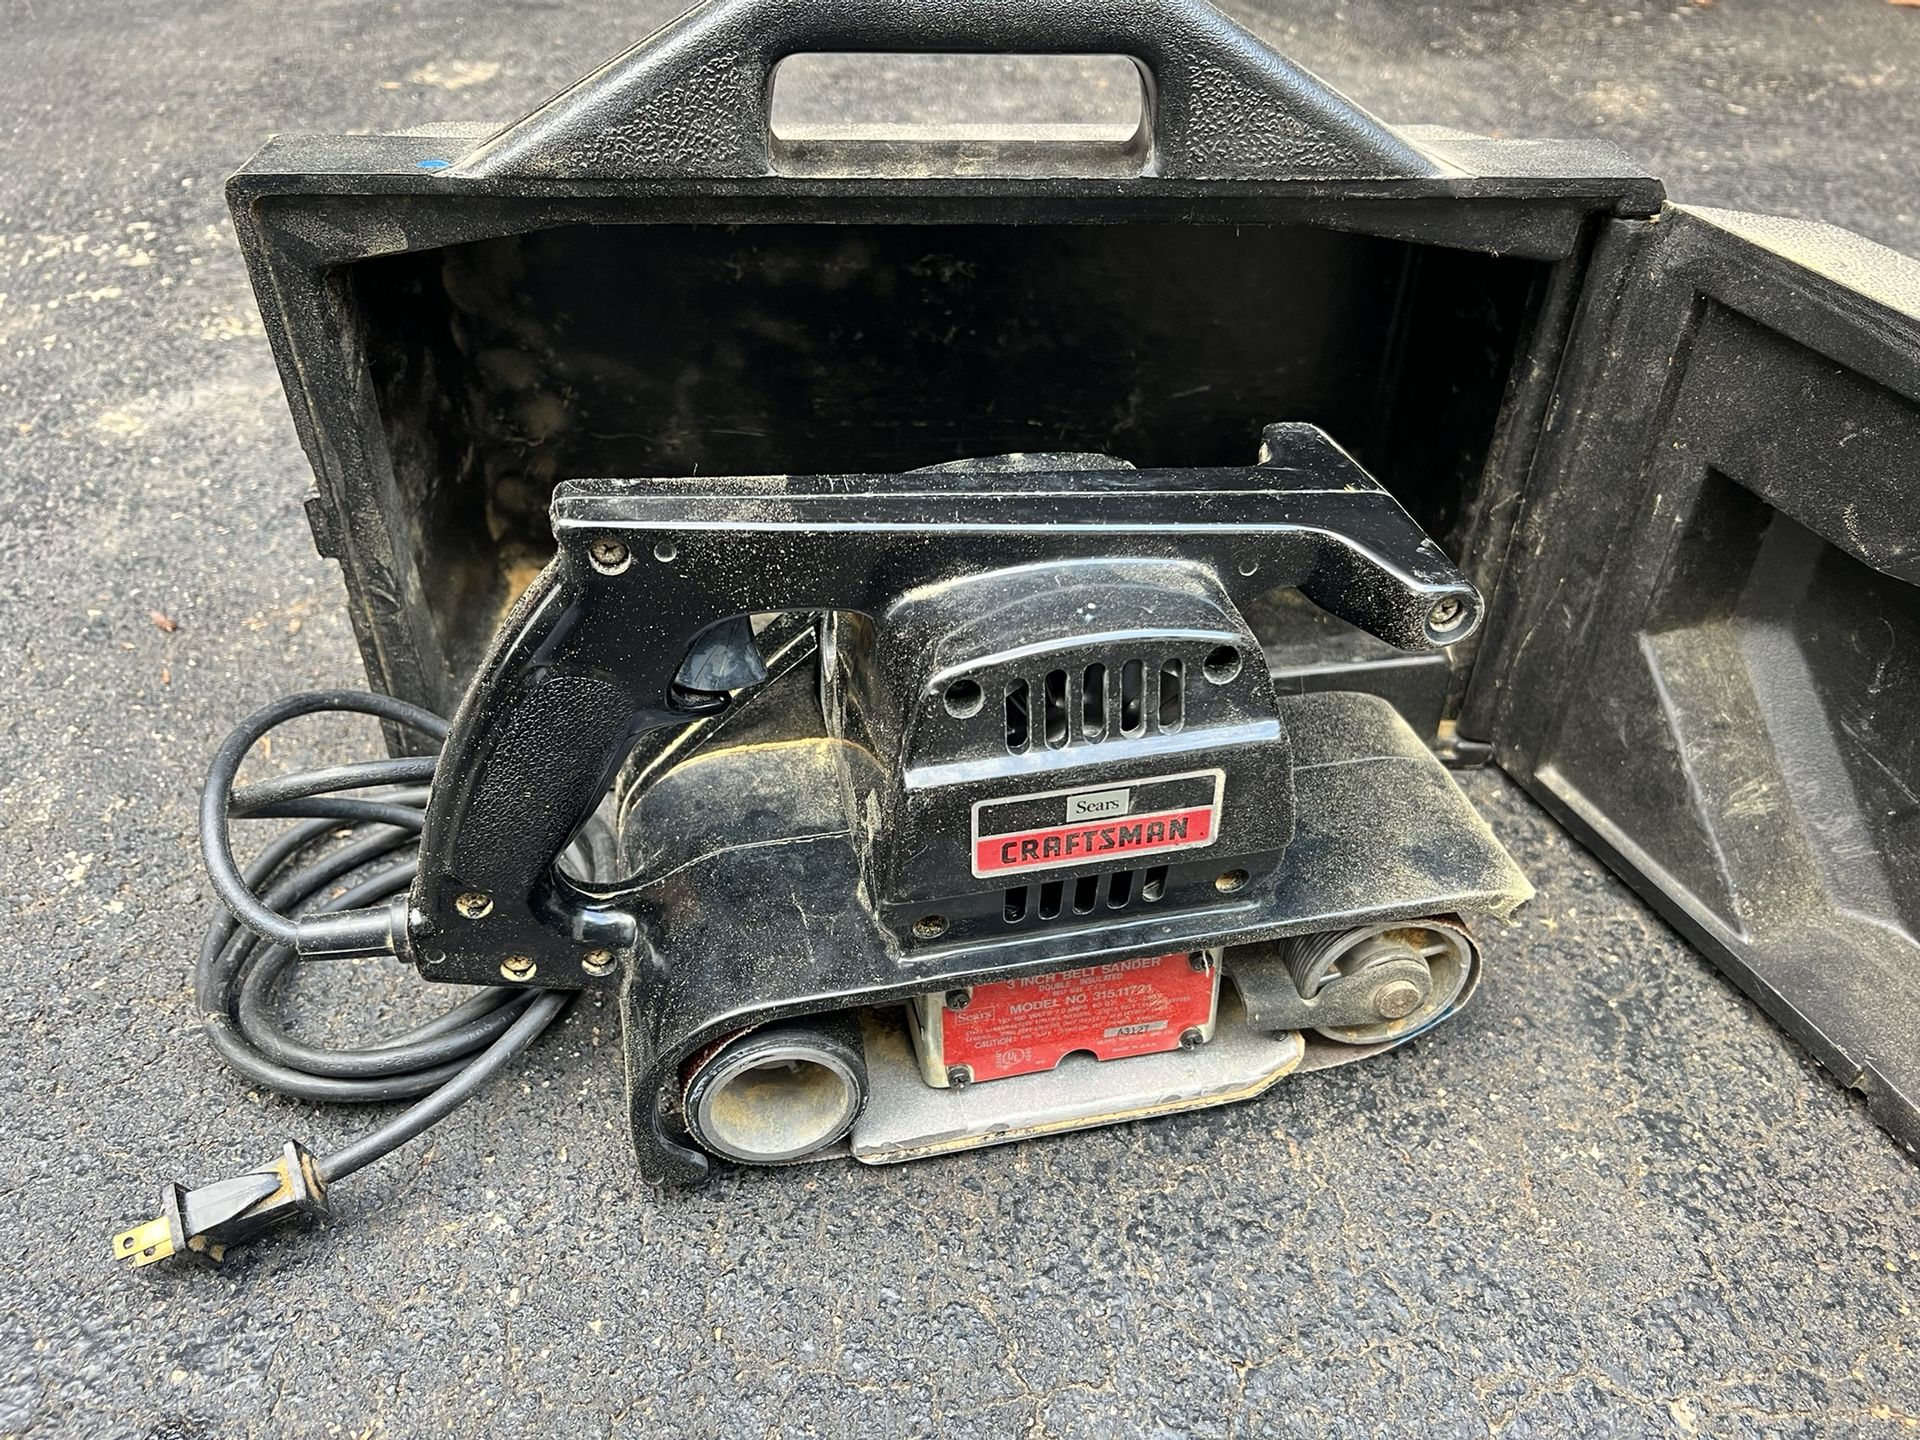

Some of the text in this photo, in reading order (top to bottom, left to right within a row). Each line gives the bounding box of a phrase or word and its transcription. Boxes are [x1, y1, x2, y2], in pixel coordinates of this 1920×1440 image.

[1075, 799, 1120, 815] Sears
[1001, 817, 1189, 864] CRAFTSMAN
[1006, 957, 1161, 990] 3 INCH BELT SANDER
[1038, 973, 1123, 992] DOUBLE INSULATED
[1009, 999, 1061, 1015] MODEL
[1065, 993, 1089, 1005] NO.
[957, 1009, 992, 1023] Sears
[1117, 1025, 1150, 1036] A3127
